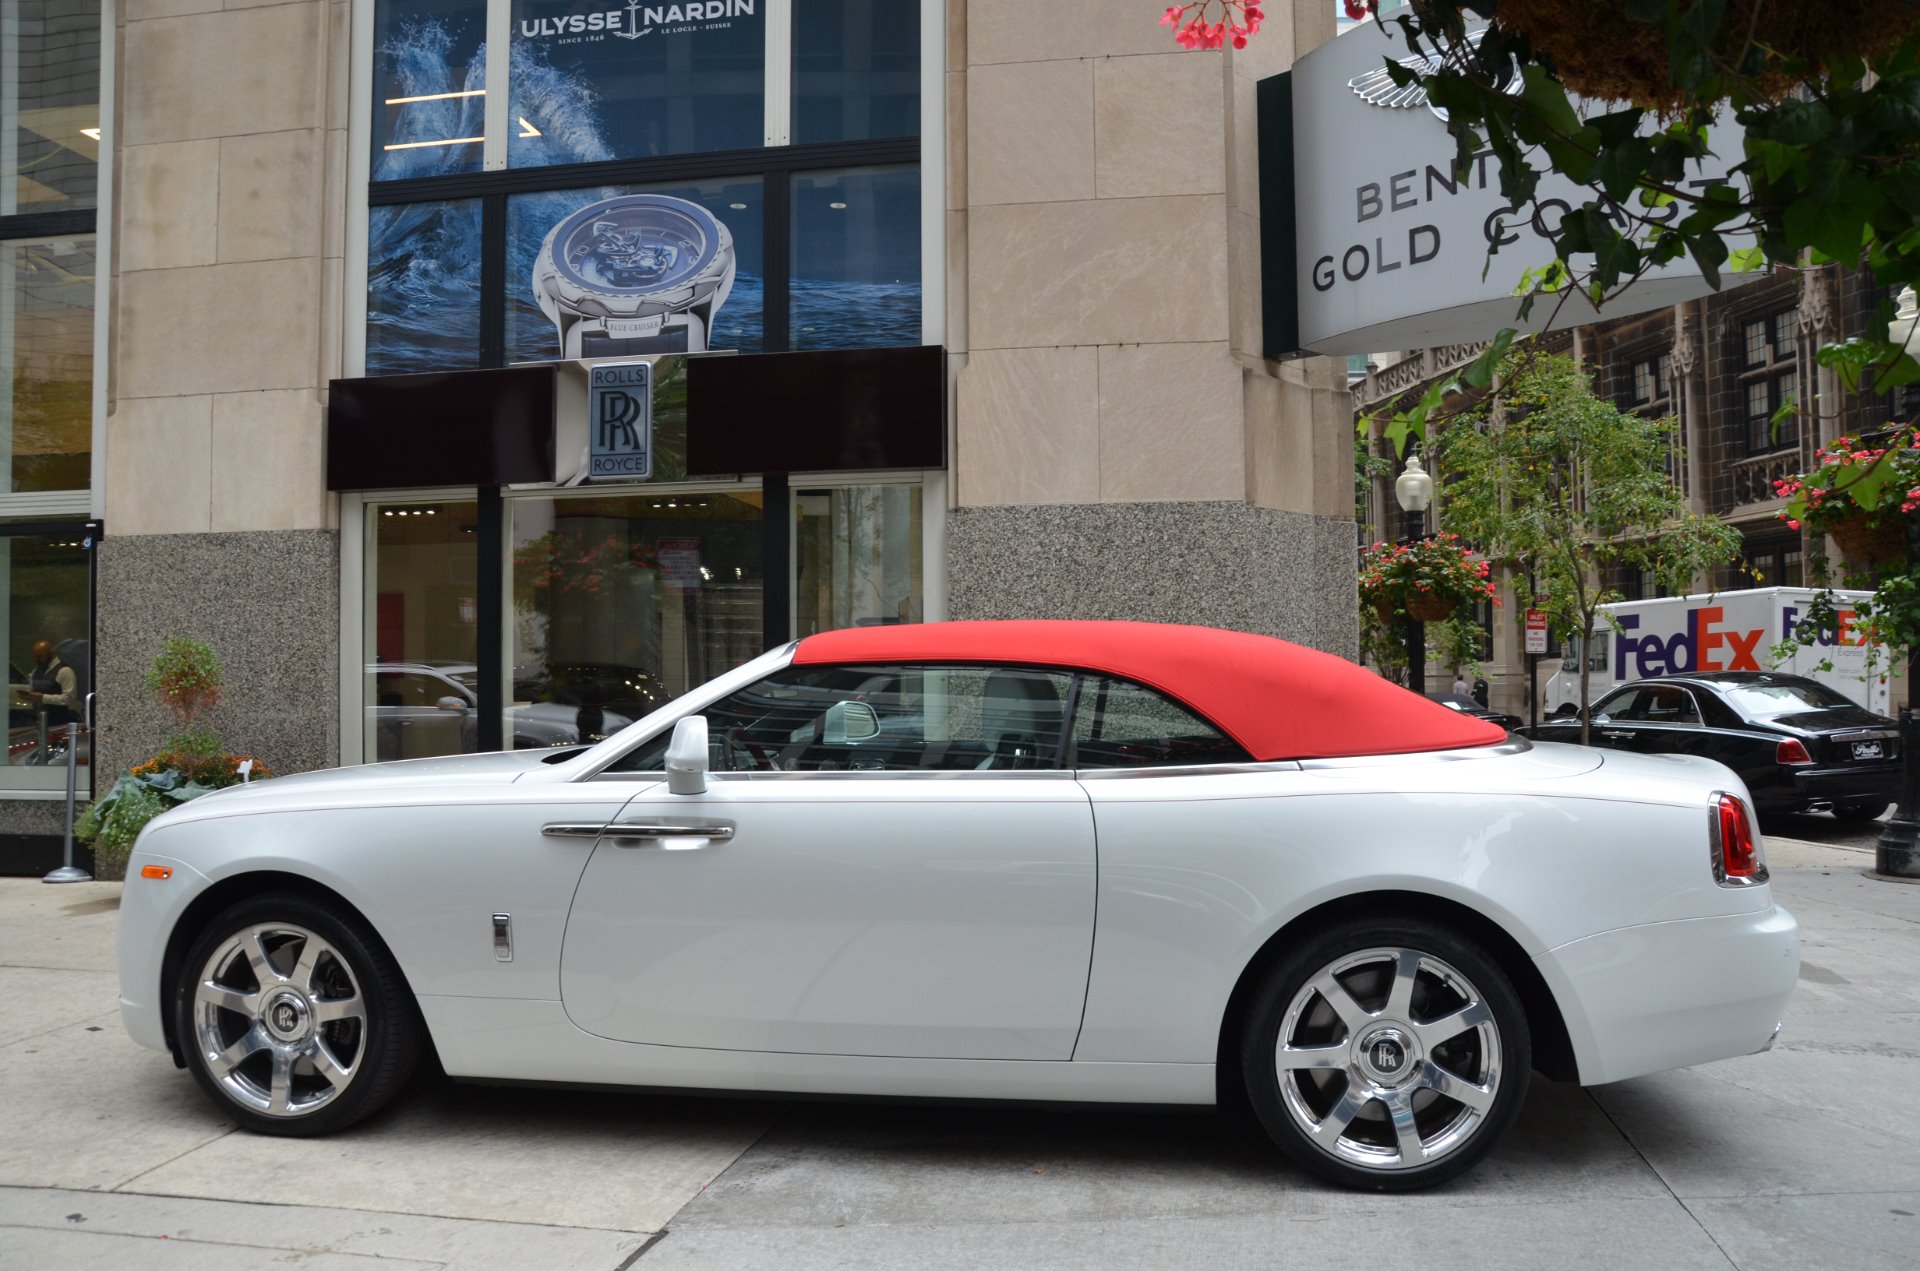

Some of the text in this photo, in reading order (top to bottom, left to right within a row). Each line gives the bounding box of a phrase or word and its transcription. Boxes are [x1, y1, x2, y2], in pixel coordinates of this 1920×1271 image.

[521, 0, 755, 38] ULYSSE NARDIN
[673, 25, 697, 33] LOCLE
[705, 22, 732, 30] SUISSE
[558, 34, 605, 45] SINCE 1846
[1312, 223, 1441, 292] GOLD
[610, 321, 659, 332] BLUE CRUISER
[595, 369, 644, 384] ROLLS
[594, 457, 643, 472] ROYCE
[1616, 606, 1765, 680] FedEx
